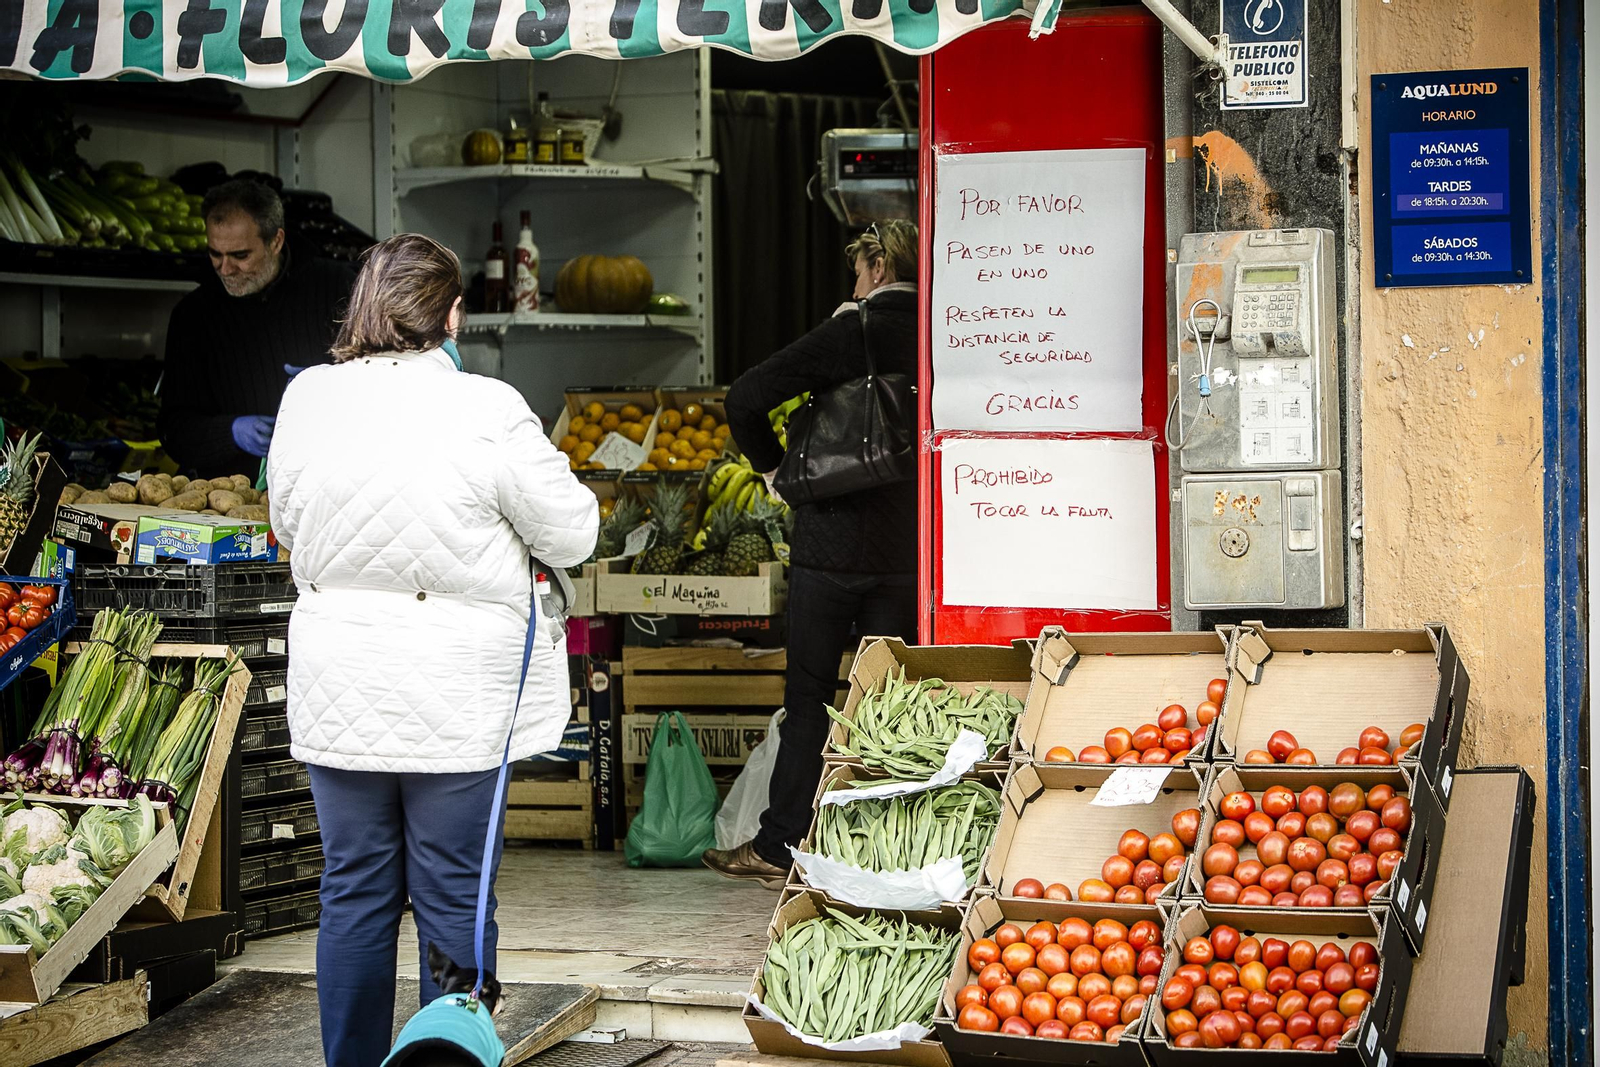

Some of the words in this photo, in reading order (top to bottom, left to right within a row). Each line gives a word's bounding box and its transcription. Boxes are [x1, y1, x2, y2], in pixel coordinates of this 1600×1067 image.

[1229, 44, 1299, 60] TELEFONO
[1233, 61, 1295, 77] PUBLICO
[1401, 83, 1497, 100] AQUALUND
[1422, 110, 1476, 121] HORARIO
[1420, 142, 1478, 154] MAÑANAS
[1411, 159, 1421, 168] de
[1423, 158, 1453, 167] 09:30h.
[1464, 157, 1489, 165] 14:15h.
[1428, 181, 1471, 192] TARDES
[959, 188, 1000, 220] POR
[1018, 194, 1084, 214] FAVOR
[1411, 198, 1421, 206] de
[1424, 197, 1448, 206] 18:15h.
[1460, 197, 1488, 205] 20:30h.
[1424, 236, 1477, 249] SÁBADOS
[947, 241, 1011, 264] PASEN
[1023, 244, 1044, 255] DE
[1059, 244, 1094, 255] UNO
[1412, 254, 1422, 262] de
[1425, 253, 1454, 262] 09:30h.
[1465, 251, 1492, 260] 14:30h.
[977, 269, 1002, 282] EN
[1012, 268, 1047, 279] UNO
[946, 306, 1034, 326] RESPETEN
[1049, 307, 1066, 316] LA
[1038, 332, 1055, 342] DE
[970, 502, 1029, 519] TOCAR
[1041, 506, 1059, 516] LA
[58, 509, 104, 531] RegalBerry
[160, 537, 185, 550] VIRTUDES
[185, 543, 195, 552] LAS
[654, 578, 667, 597] El
[672, 583, 720, 604] Maquina
[698, 619, 770, 632] Frudecas
[702, 728, 740, 758] FRUTAS
